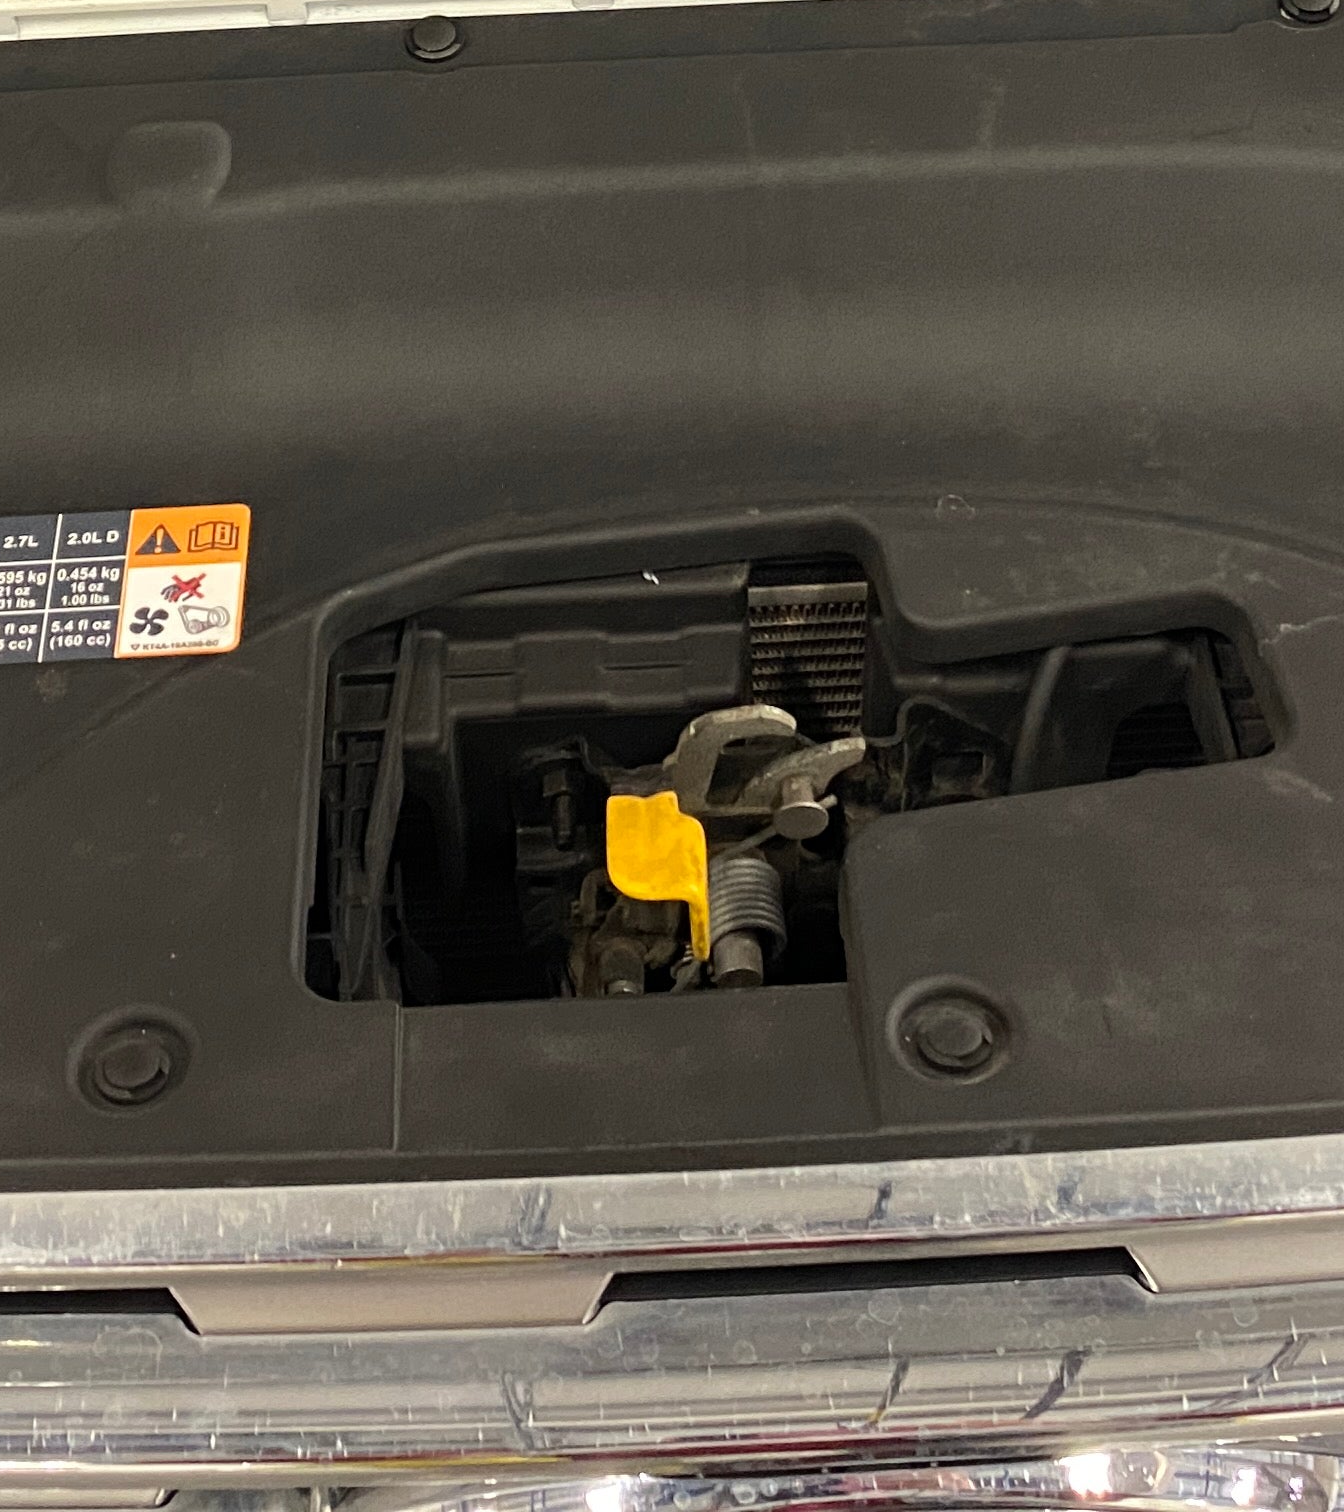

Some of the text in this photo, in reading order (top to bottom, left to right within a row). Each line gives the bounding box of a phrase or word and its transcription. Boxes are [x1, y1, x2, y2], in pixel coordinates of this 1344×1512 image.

[3, 534, 39, 548] 2.7L
[67, 530, 120, 546] 2.0L D
[27, 570, 47, 586] kg
[56, 566, 120, 582] 0.454 kg
[14, 587, 31, 597] oz
[70, 583, 104, 593] 16 oz
[16, 598, 36, 609] lbs
[61, 594, 110, 606] 1.00 lbs
[4, 623, 17, 635] fl
[18, 624, 38, 634] oz
[50, 619, 111, 633] 5.4 fl oz
[8, 637, 33, 652] cc)
[49, 633, 111, 650] (160 cc)
